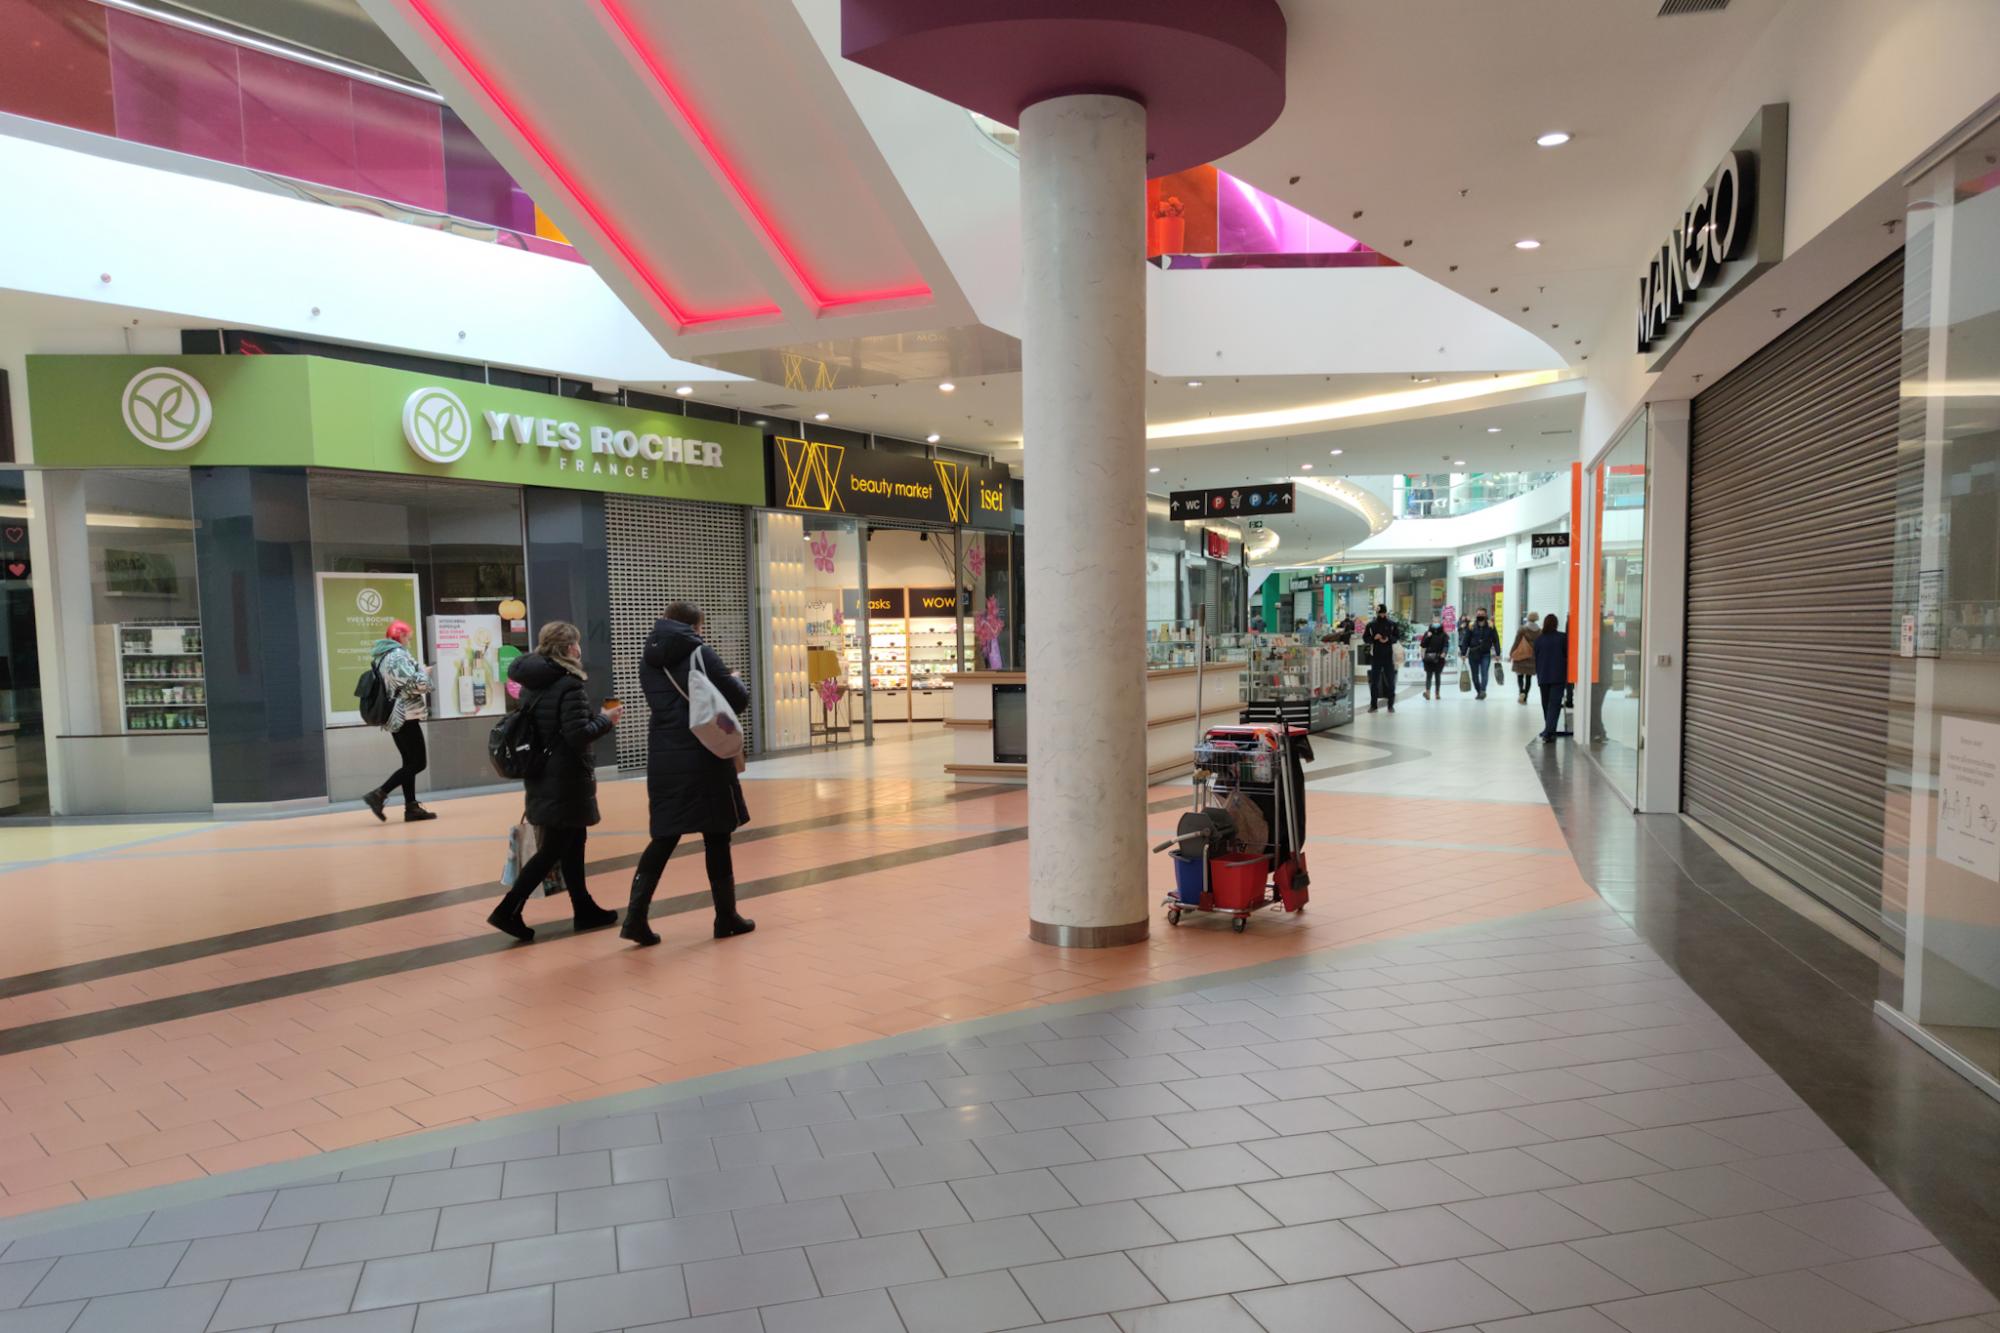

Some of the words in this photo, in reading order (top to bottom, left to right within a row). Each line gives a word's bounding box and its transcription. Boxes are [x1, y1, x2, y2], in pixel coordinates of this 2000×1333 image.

[1637, 149, 1752, 353] MANGO
[483, 409, 583, 451] YVES
[590, 425, 724, 468] ROCHER
[559, 457, 650, 480] FRANCE
[850, 474, 894, 498] beauty
[895, 482, 933, 499] market
[980, 479, 1004, 512] isei
[1185, 499, 1201, 511] WC
[922, 596, 956, 609] WOW
